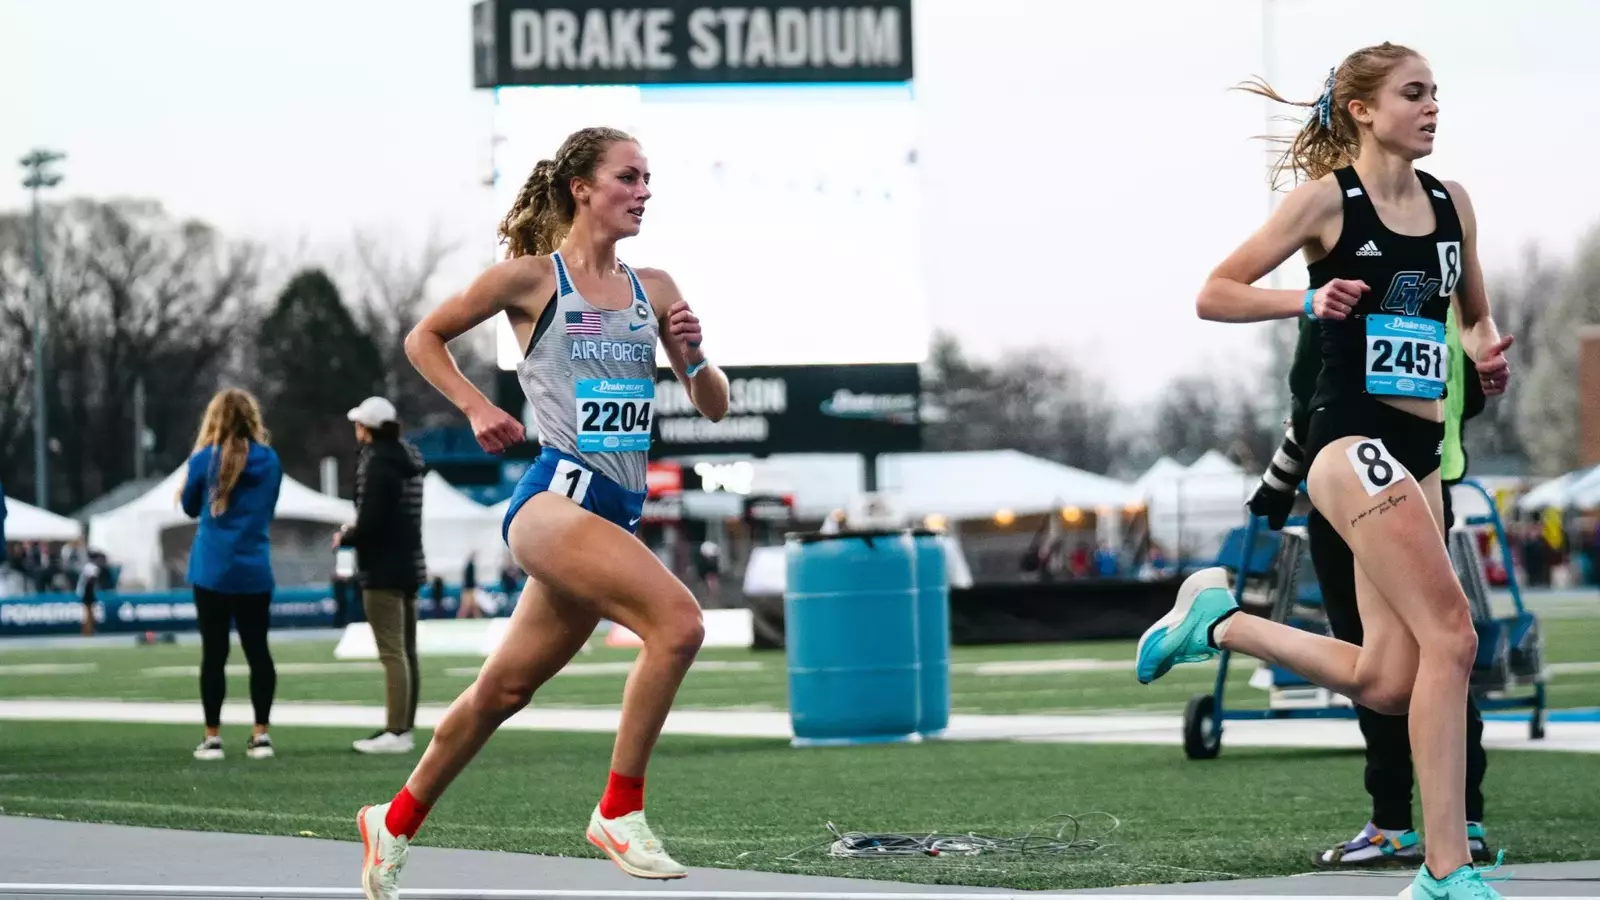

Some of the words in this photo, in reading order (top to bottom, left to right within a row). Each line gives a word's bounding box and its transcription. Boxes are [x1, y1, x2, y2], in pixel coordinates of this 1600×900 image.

[510, 8, 676, 70] DRAKE
[687, 5, 900, 69] STADIUM
[1445, 244, 1457, 294] 8
[1393, 317, 1419, 330] Drake
[571, 340, 599, 360] AIR
[600, 341, 652, 363] FORCE
[1371, 339, 1442, 379] 2451
[600, 380, 625, 391] Drake
[581, 401, 650, 432] 2204
[1357, 442, 1393, 487] 8
[566, 468, 582, 499] 1
